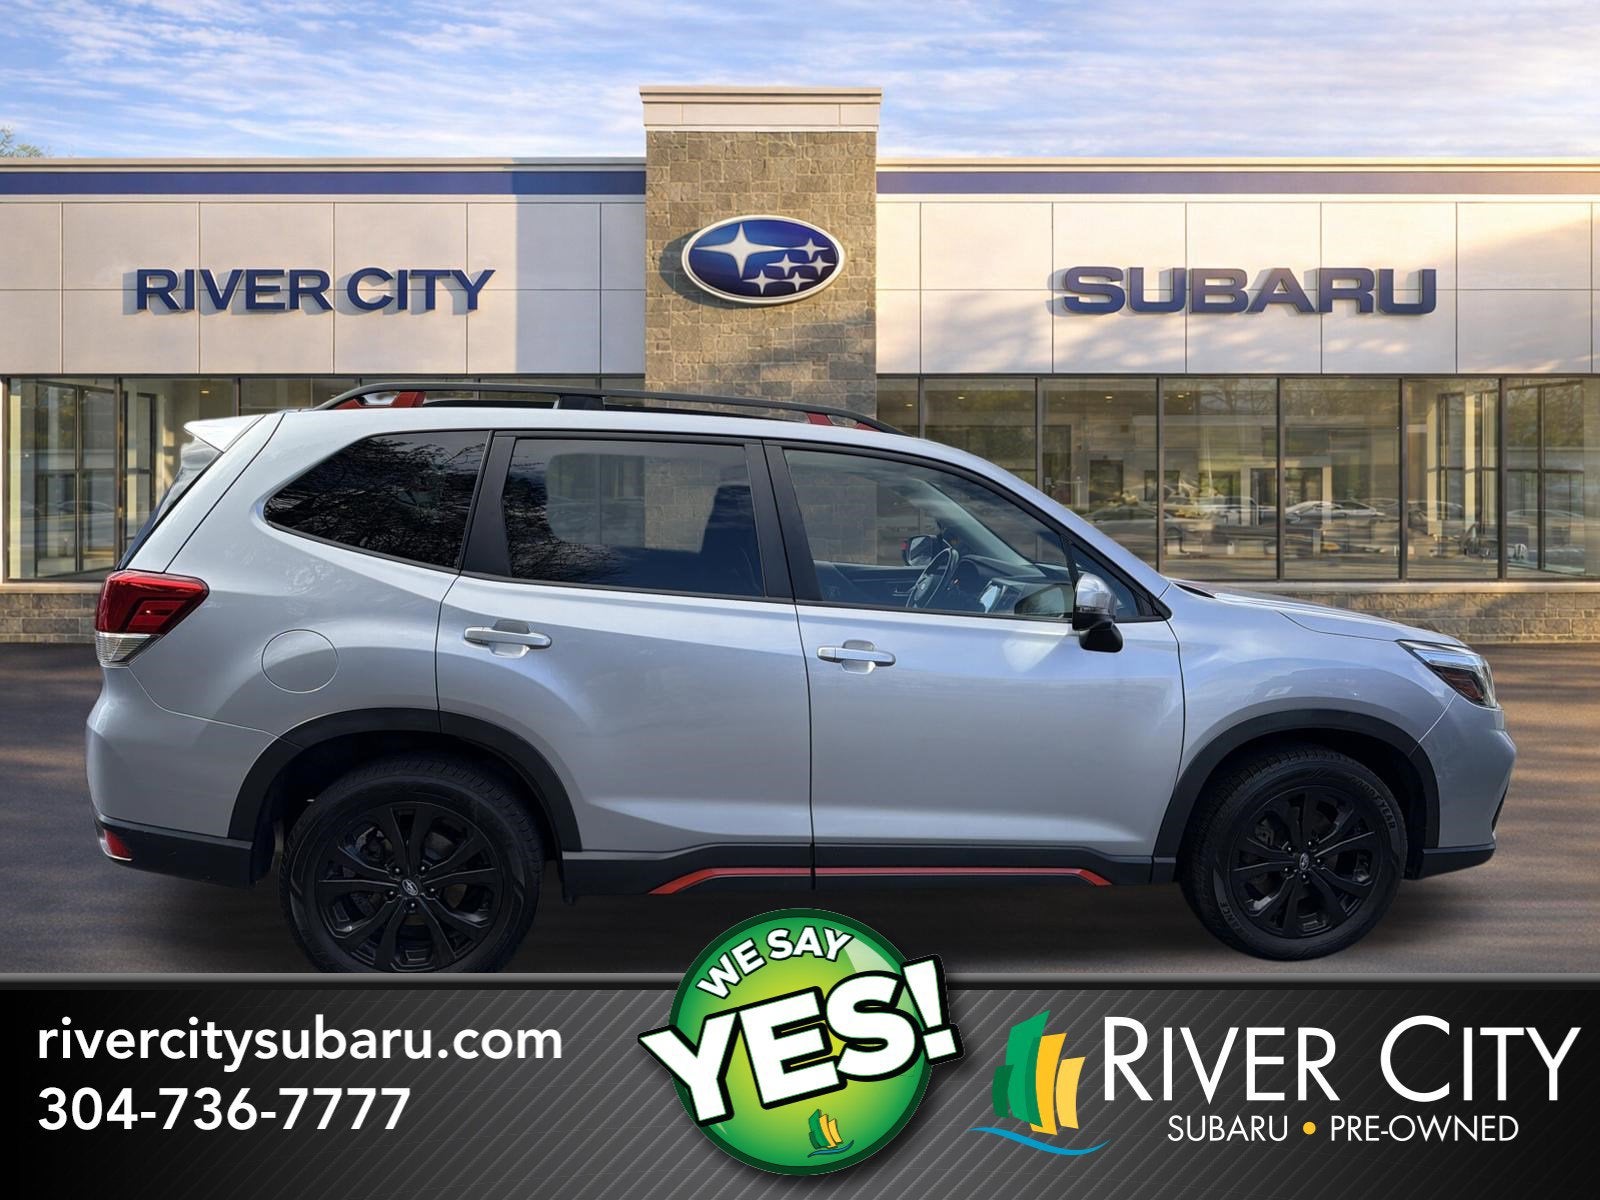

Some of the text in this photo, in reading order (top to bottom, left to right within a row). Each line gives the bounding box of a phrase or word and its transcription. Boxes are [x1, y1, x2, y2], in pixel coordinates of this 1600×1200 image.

[136, 266, 495, 311] RIVER CITY
[1062, 266, 1437, 315] SUBARU
